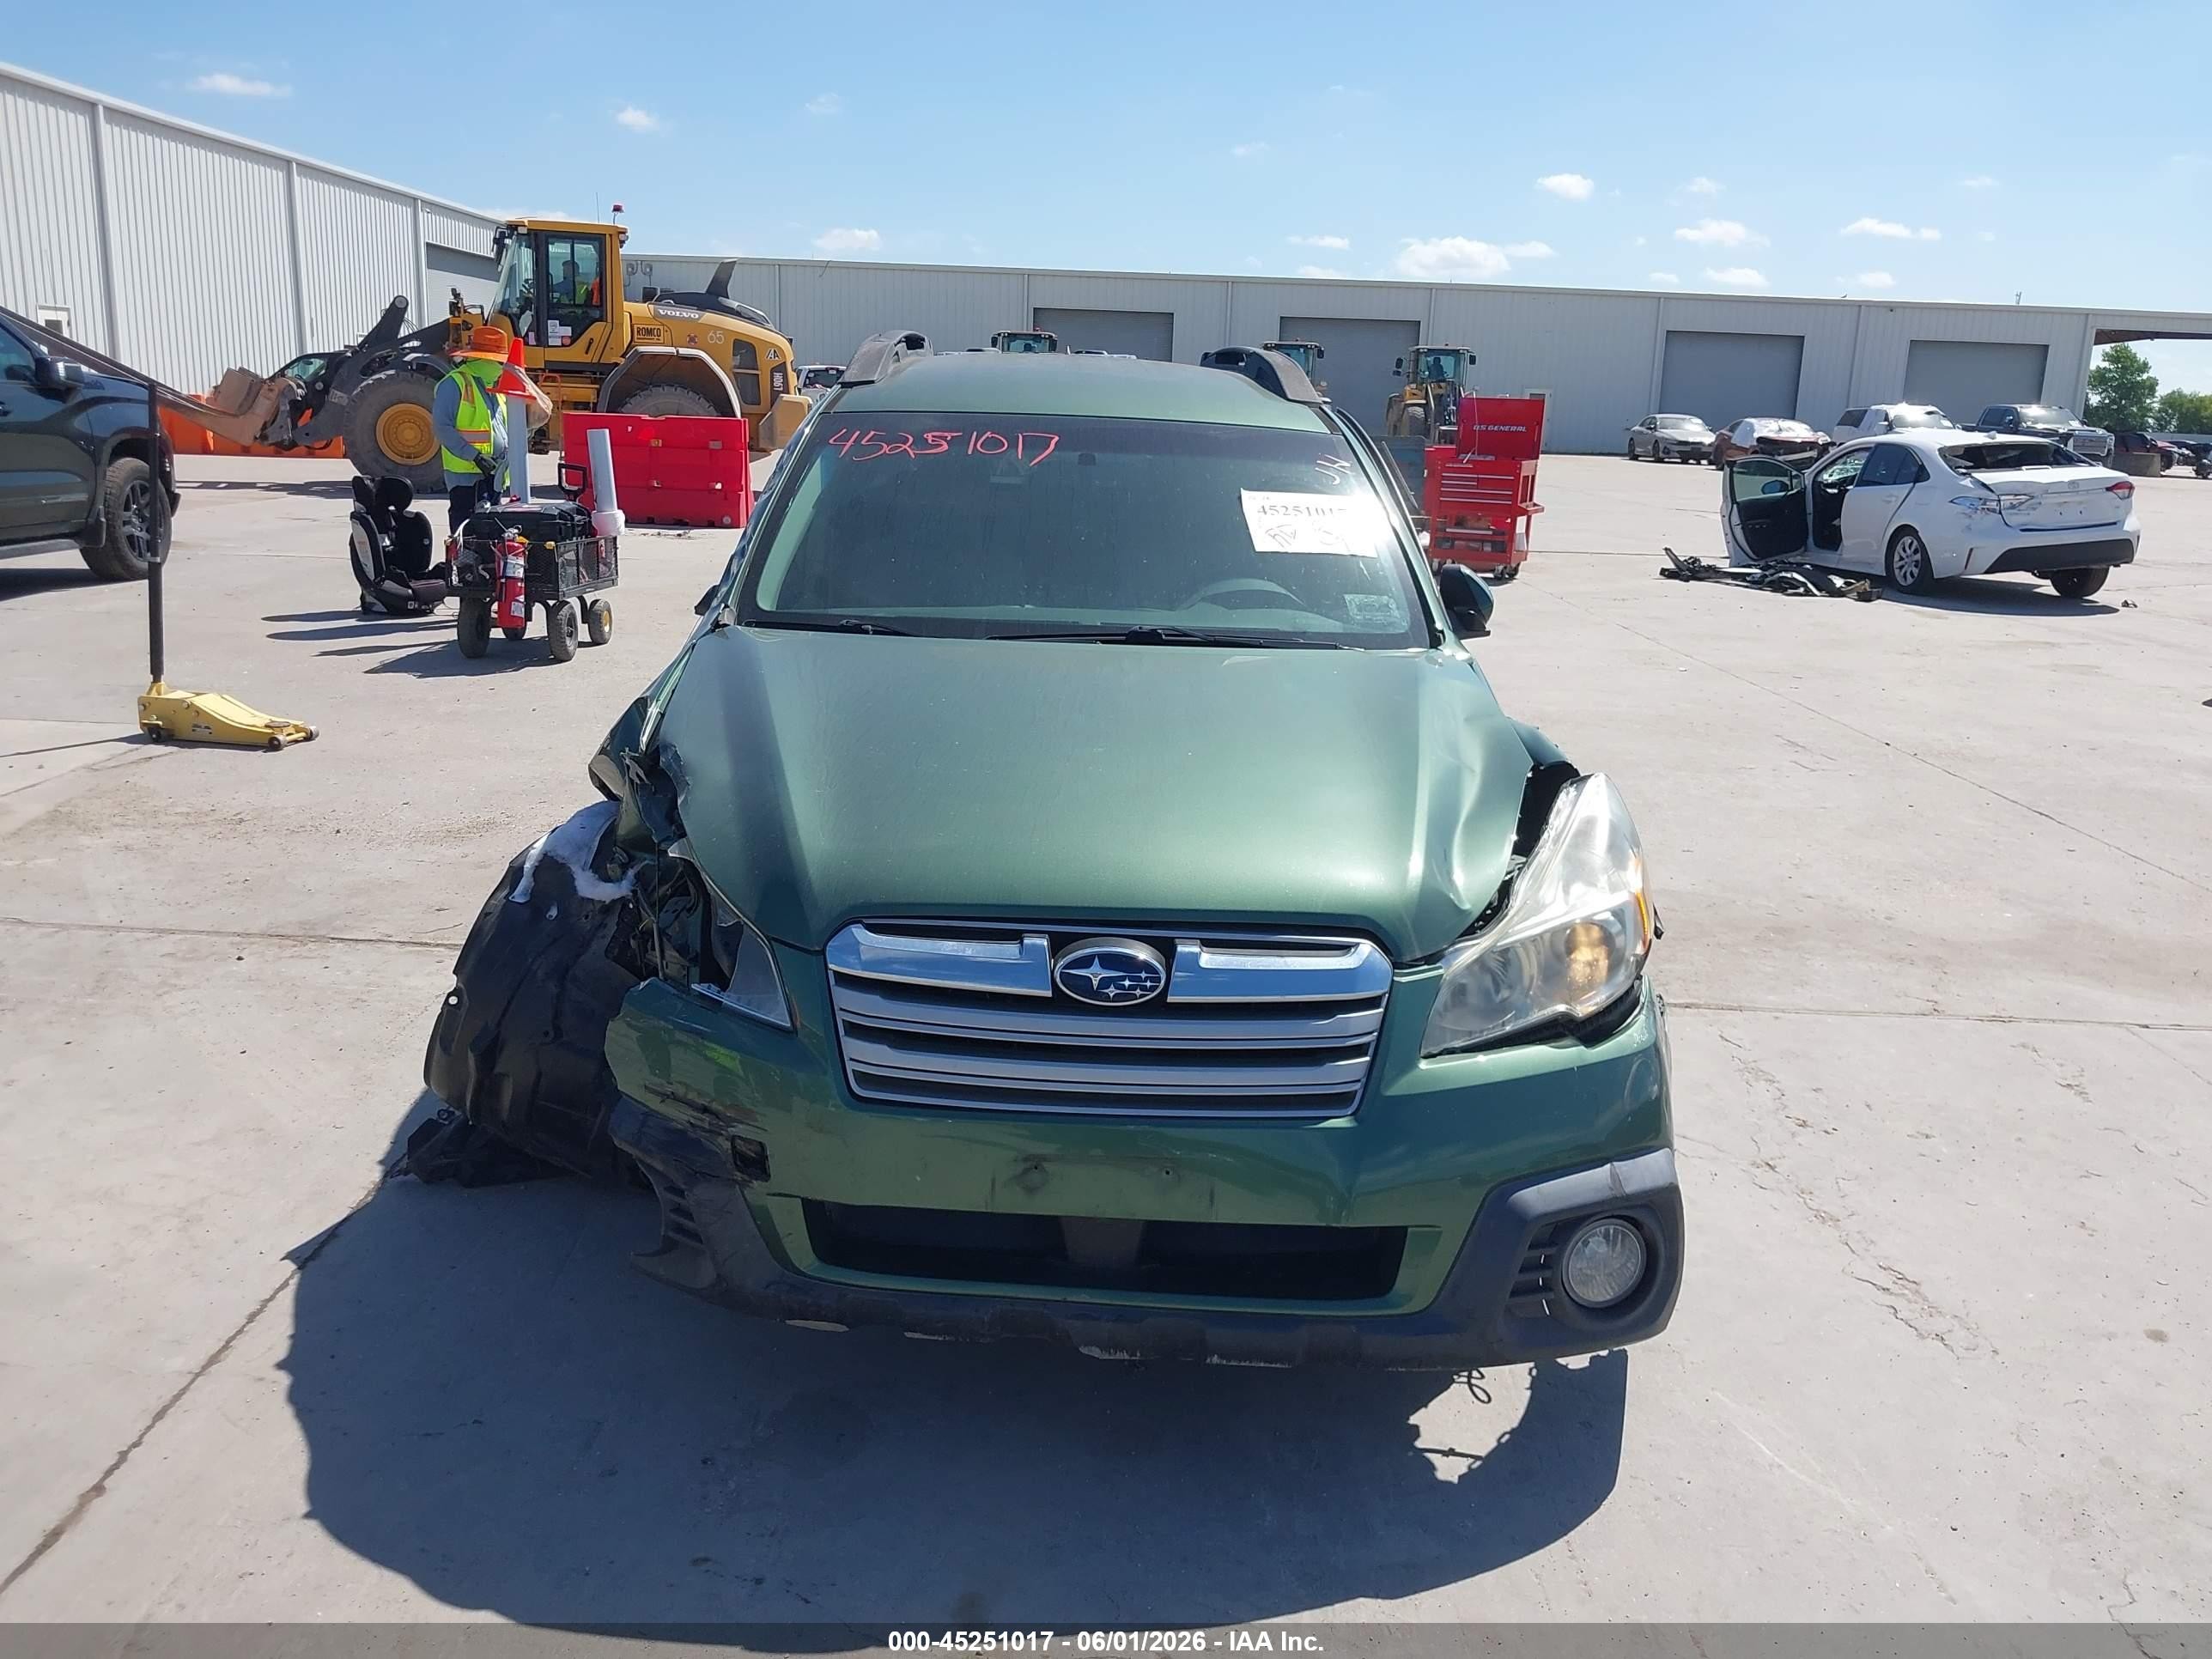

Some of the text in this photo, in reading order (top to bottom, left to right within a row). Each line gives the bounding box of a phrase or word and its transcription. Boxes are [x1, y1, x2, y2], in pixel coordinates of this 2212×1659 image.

[658, 308, 700, 319] VOLVO
[636, 326, 661, 337] ROMCO
[707, 330, 725, 344] 65
[773, 372, 784, 392] L90H
[829, 428, 1060, 467] 45251017
